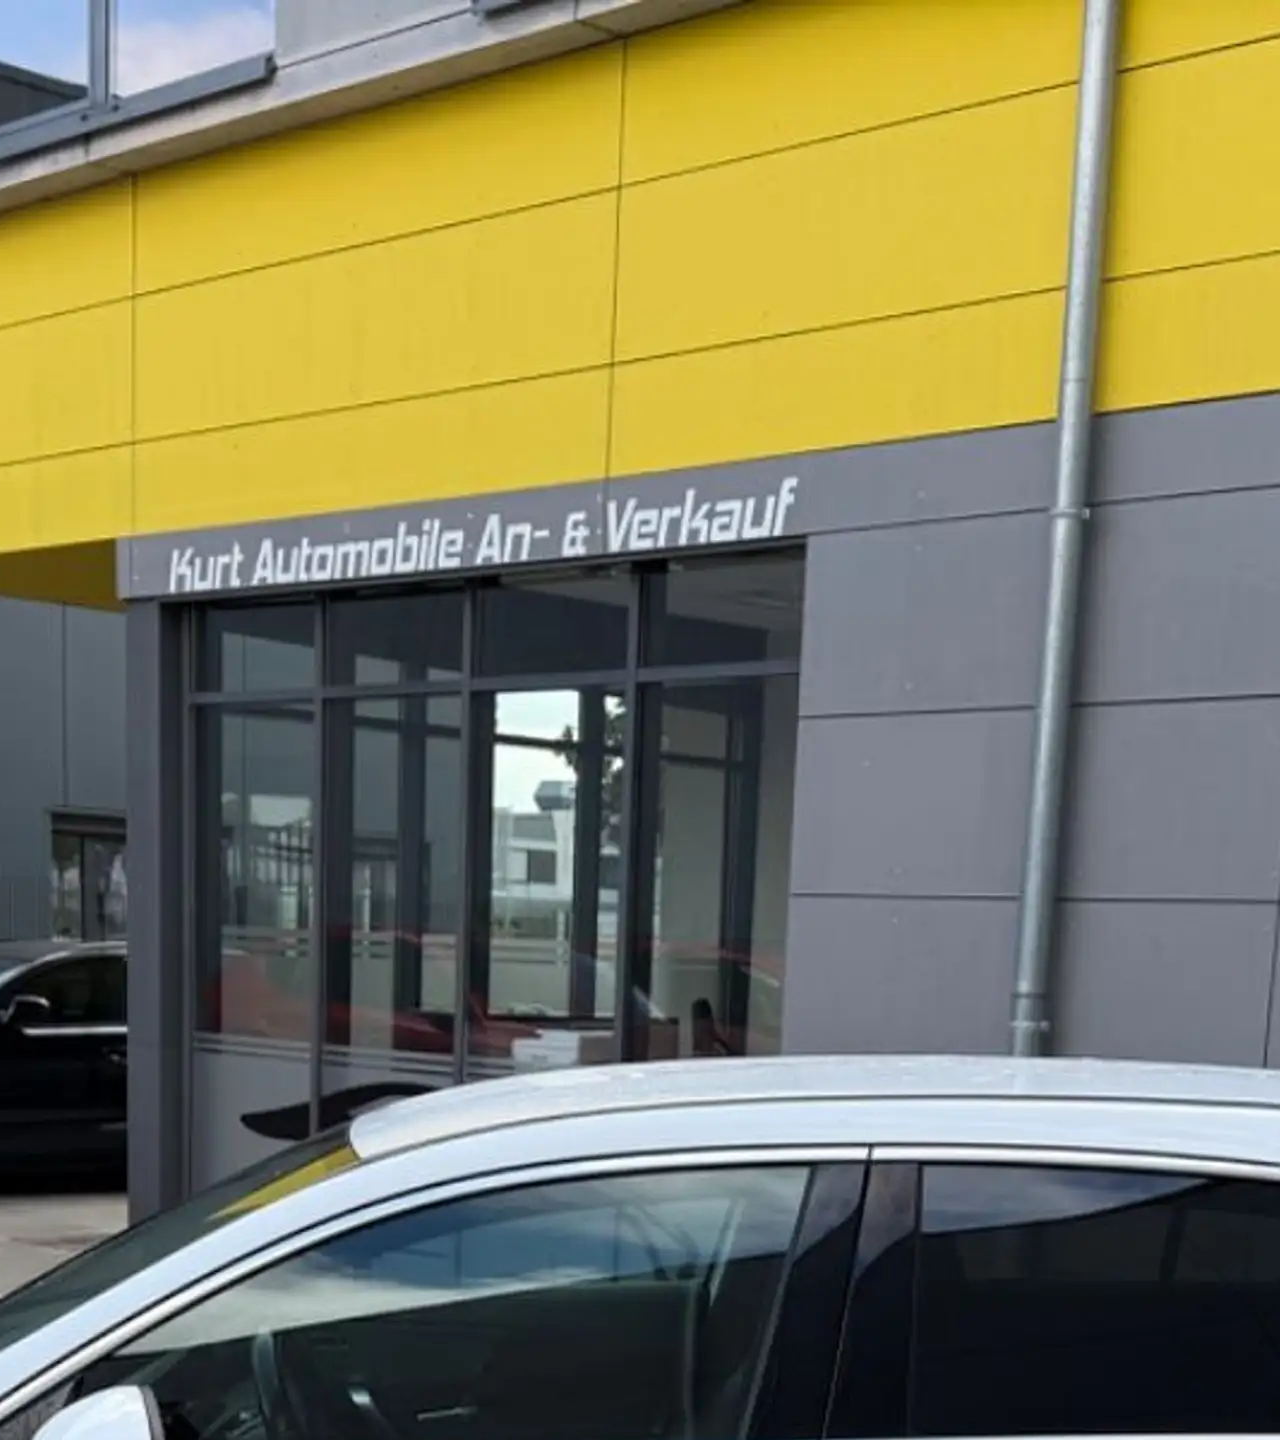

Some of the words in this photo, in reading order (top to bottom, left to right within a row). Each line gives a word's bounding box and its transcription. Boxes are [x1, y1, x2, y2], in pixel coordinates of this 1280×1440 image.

[169, 541, 244, 594] Kurt
[251, 518, 465, 586] Automobile
[475, 512, 550, 566] An-
[561, 510, 590, 558] &
[606, 475, 800, 553] Verkauf
